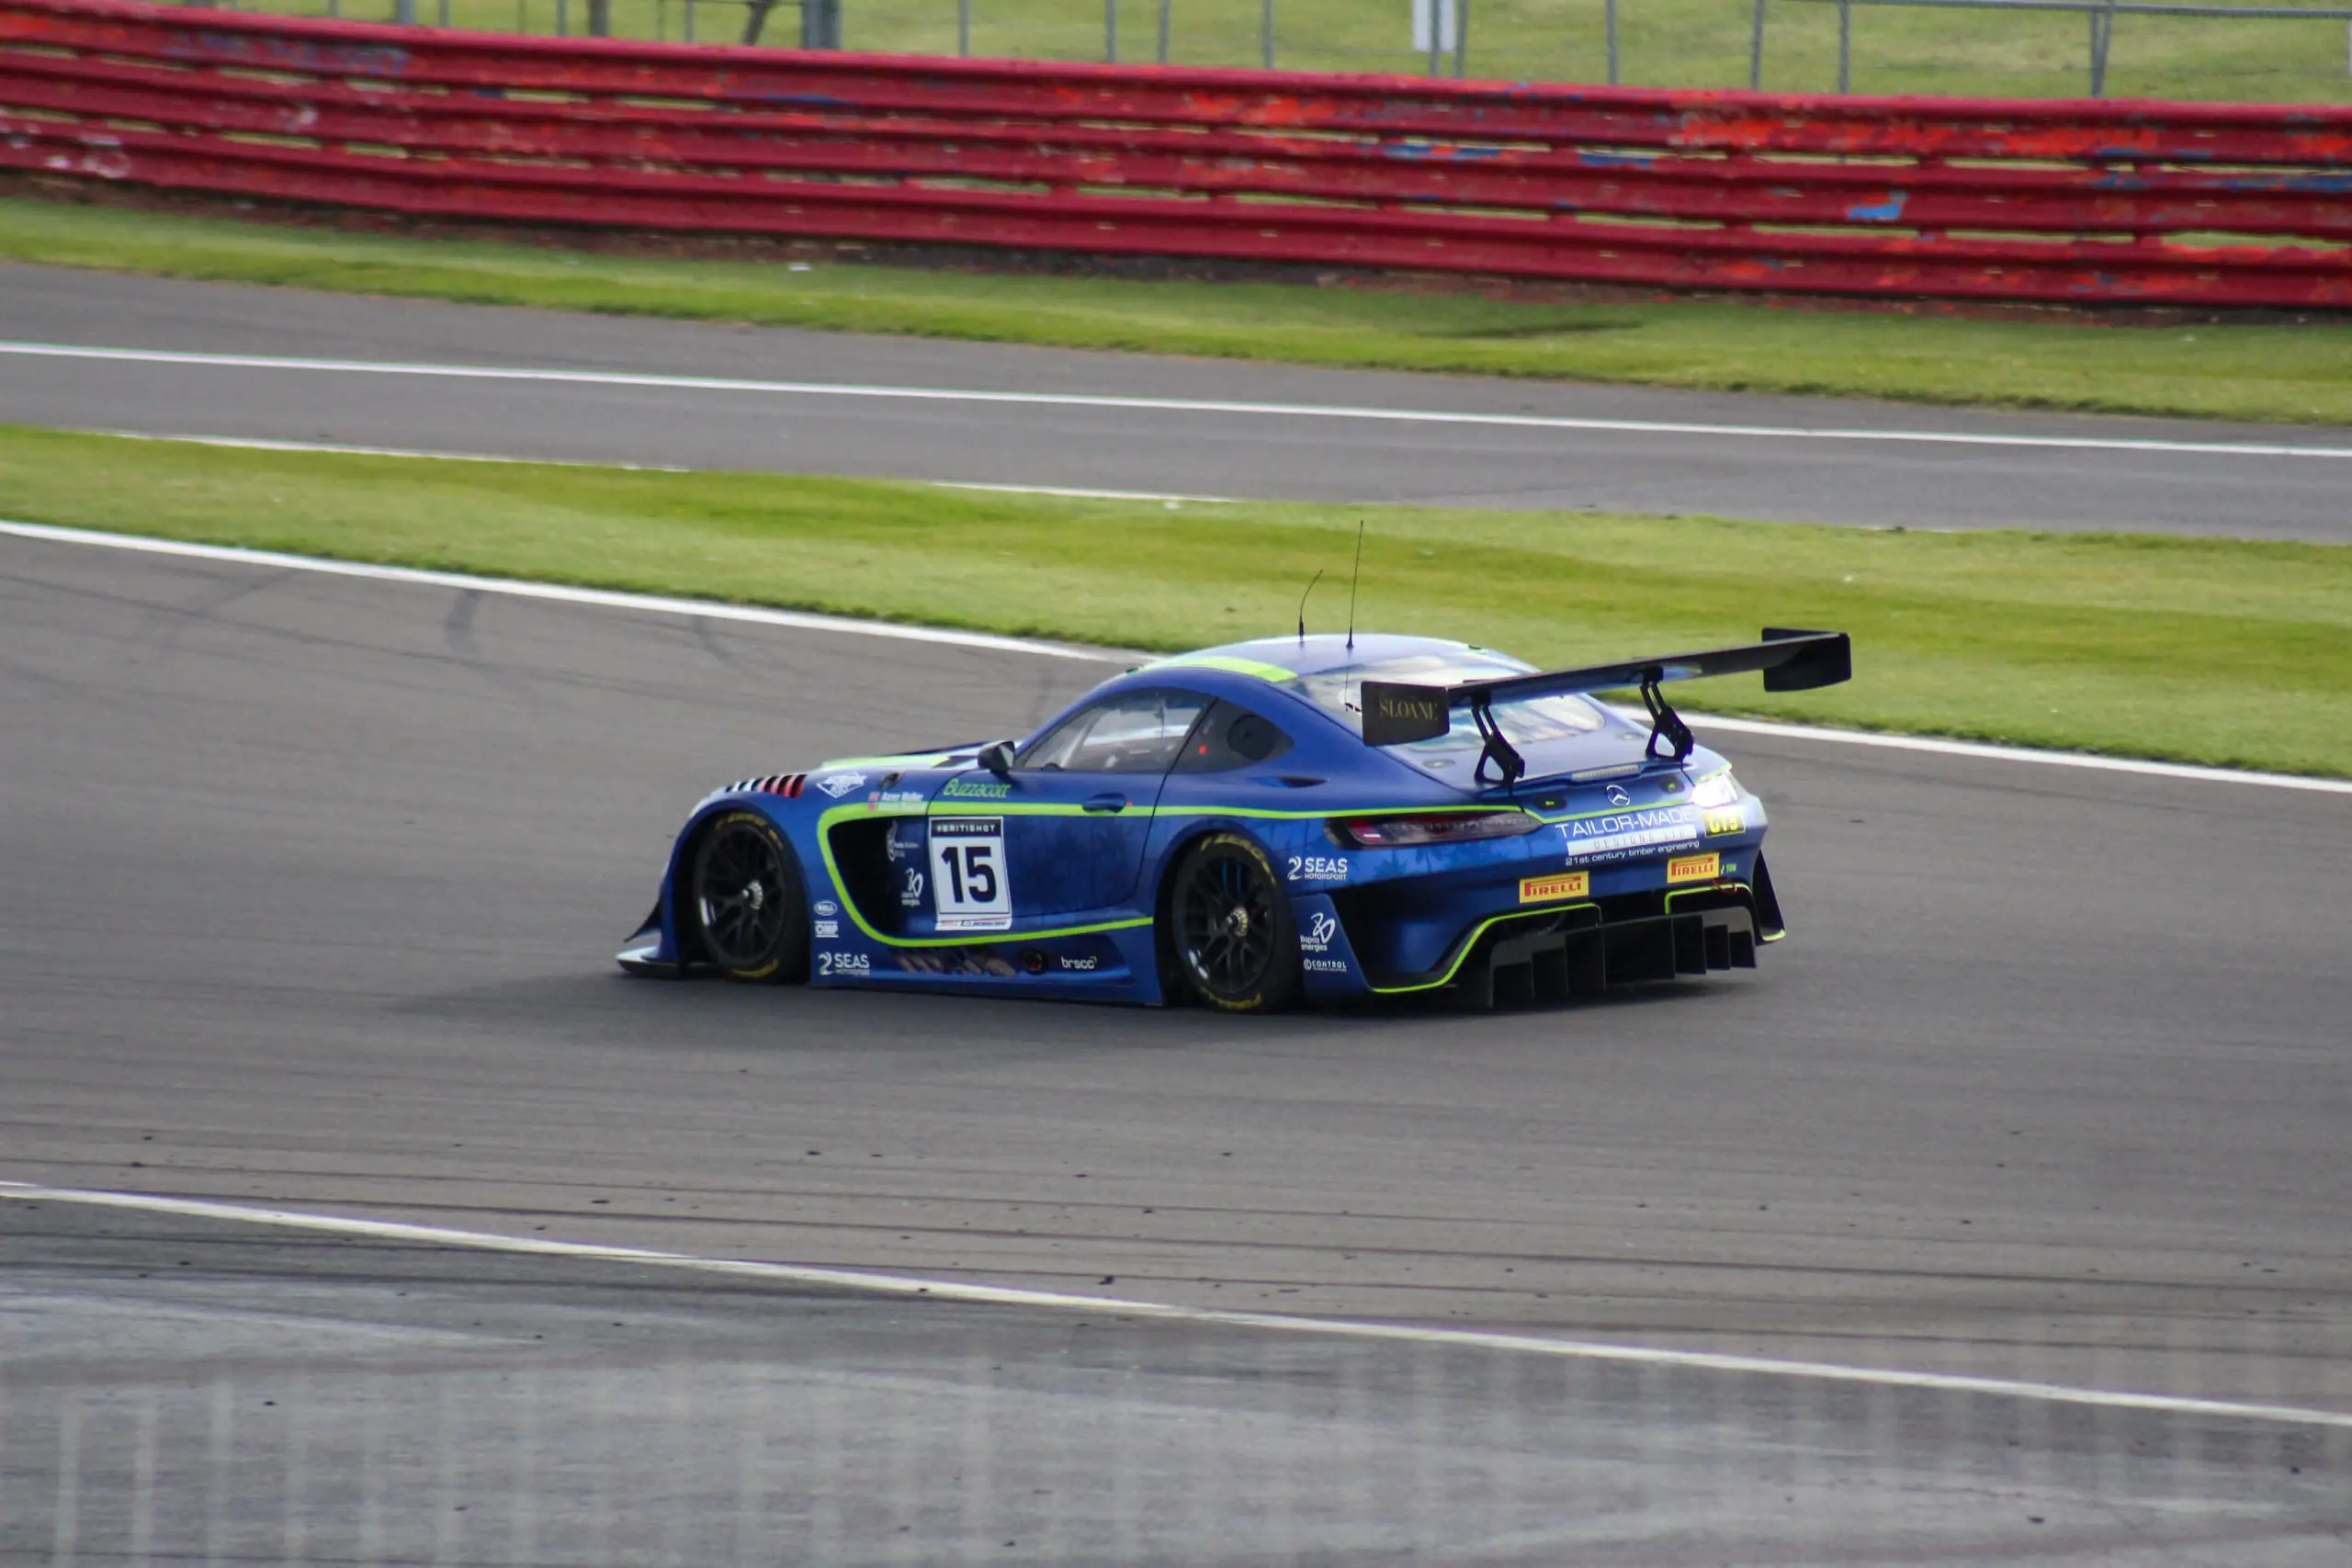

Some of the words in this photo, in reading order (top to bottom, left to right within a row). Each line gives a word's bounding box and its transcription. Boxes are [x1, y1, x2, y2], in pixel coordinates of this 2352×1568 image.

[1379, 698, 1439, 721] SLOANE
[1555, 808, 1693, 839] TAILOR-MADE
[1591, 851, 1625, 863] century
[1628, 846, 1657, 857] timber
[1658, 840, 1700, 853] engineering
[941, 846, 997, 903] 15
[1305, 857, 1348, 874] SEAS
[1670, 856, 1714, 878] PIRELLI
[1524, 875, 1582, 897] PIRELLI
[834, 953, 870, 969] SEAS
